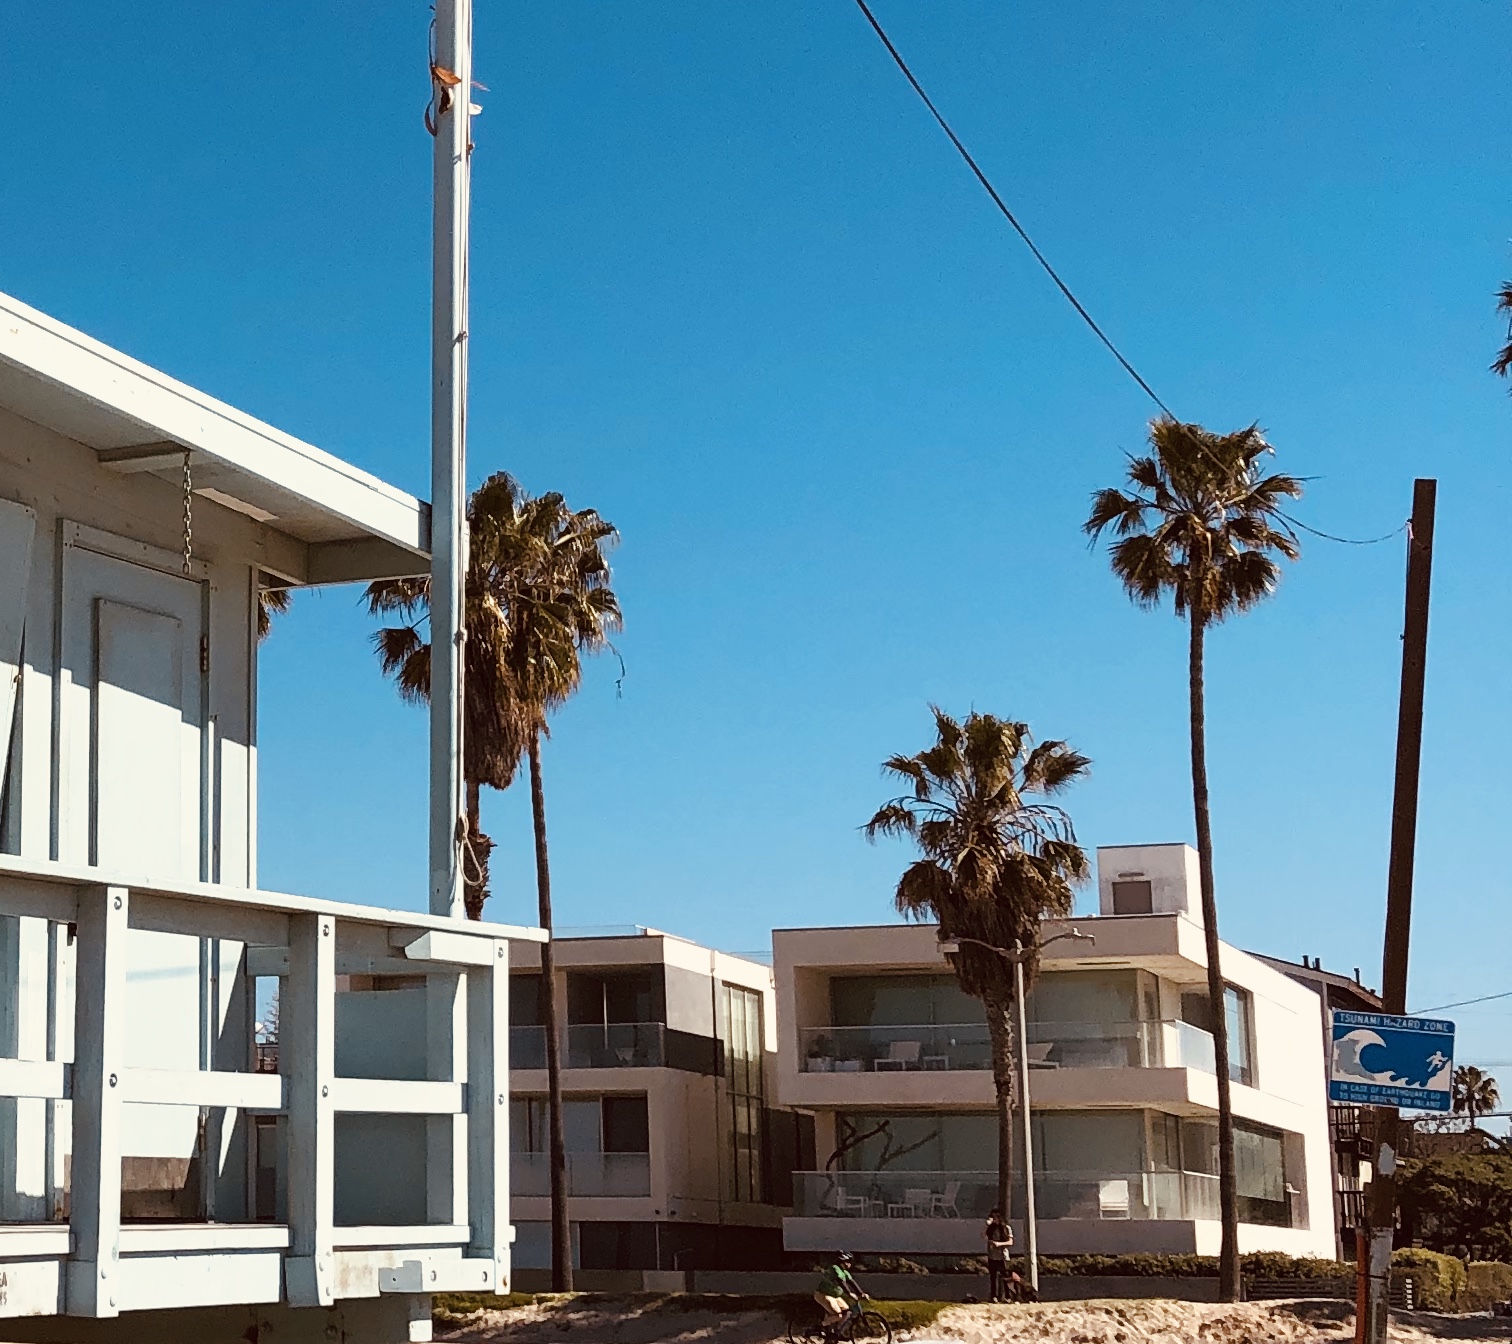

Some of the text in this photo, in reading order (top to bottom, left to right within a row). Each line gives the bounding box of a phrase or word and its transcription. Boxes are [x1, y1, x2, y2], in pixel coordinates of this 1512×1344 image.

[1339, 1013, 1380, 1026] TSUNAMI
[1423, 1022, 1449, 1032] ZONE
[1370, 1086, 1379, 1094] OF
